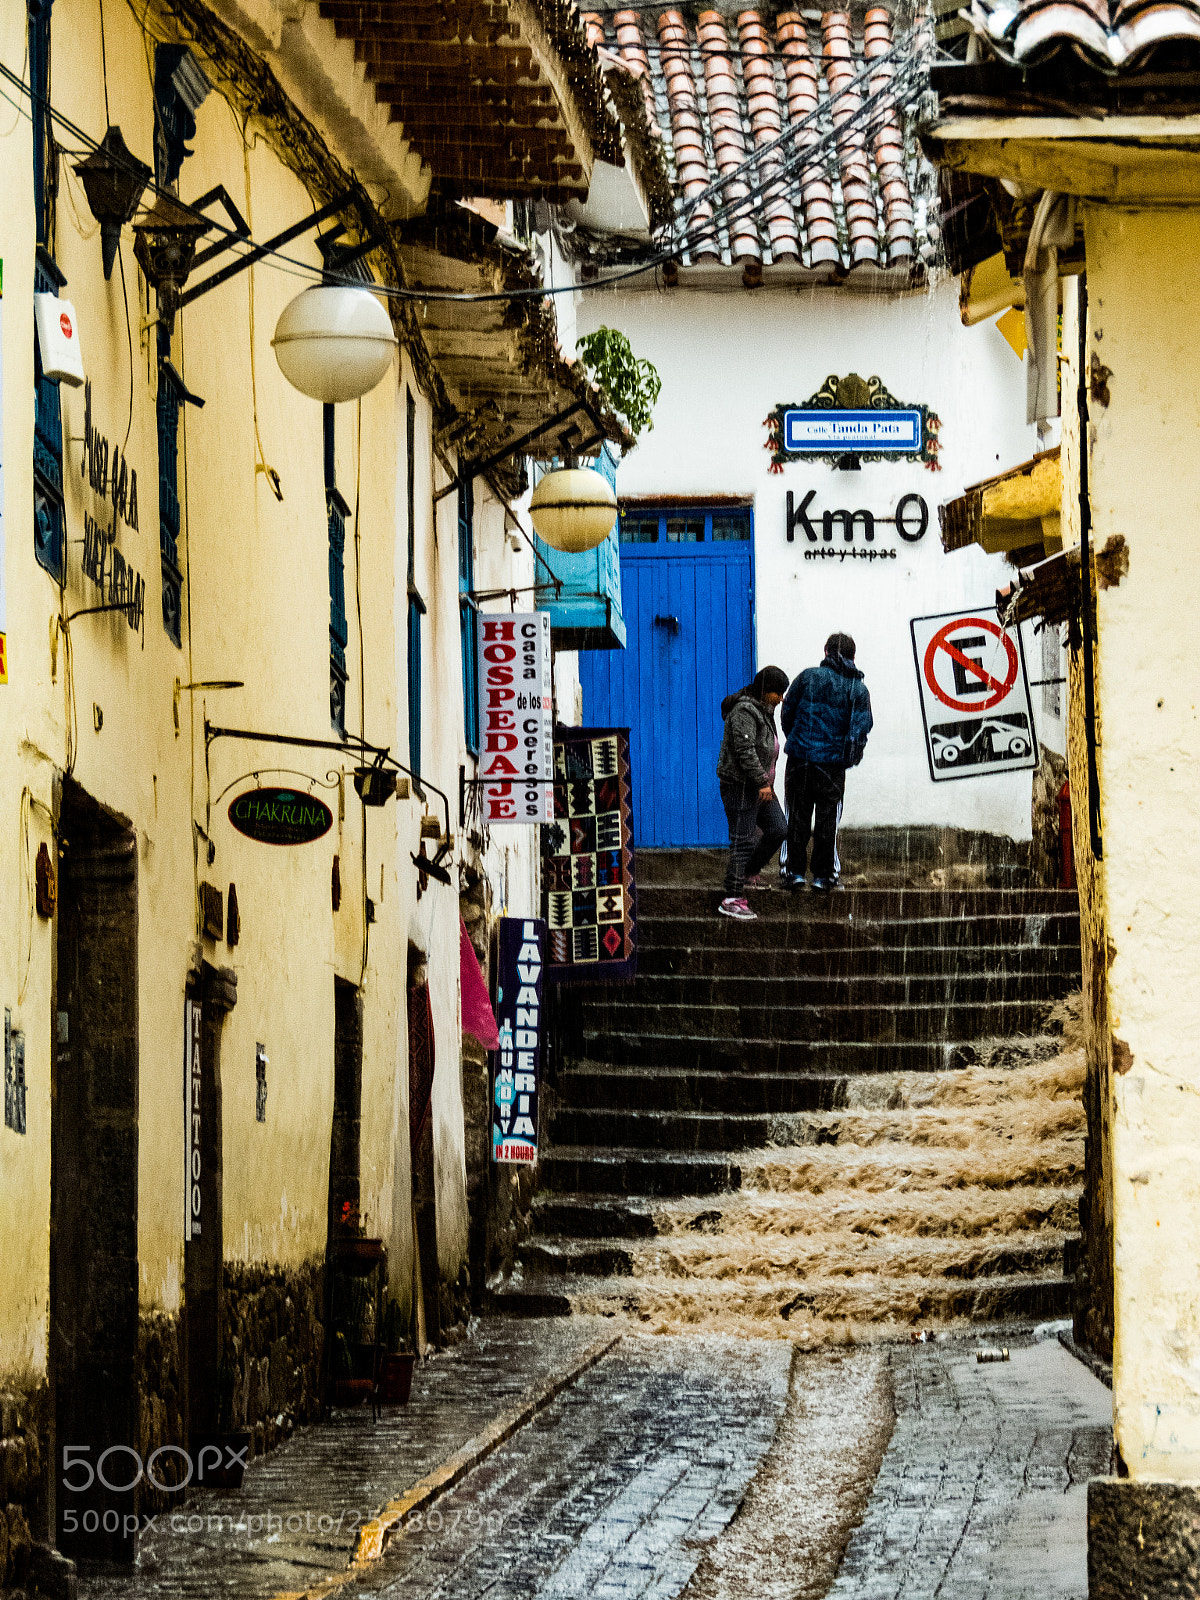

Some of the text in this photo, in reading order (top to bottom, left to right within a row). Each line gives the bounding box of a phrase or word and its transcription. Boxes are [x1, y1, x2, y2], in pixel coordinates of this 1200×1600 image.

[807, 422, 900, 434] Calle Tanda Pata
[786, 489, 875, 542] Km
[804, 546, 897, 562] arte y tapas
[520, 623, 537, 680] Casa
[949, 635, 993, 696] E
[482, 621, 520, 819] HOSPEDAJE
[517, 691, 542, 710] de los
[235, 800, 326, 827] CHAKRUNA
[512, 920, 541, 1136] LAVANDERIA
[500, 1017, 514, 1136] LAUNDRY
[191, 1006, 202, 1217] TATTOO
[495, 1144, 534, 1161] IN 2 HOURS
